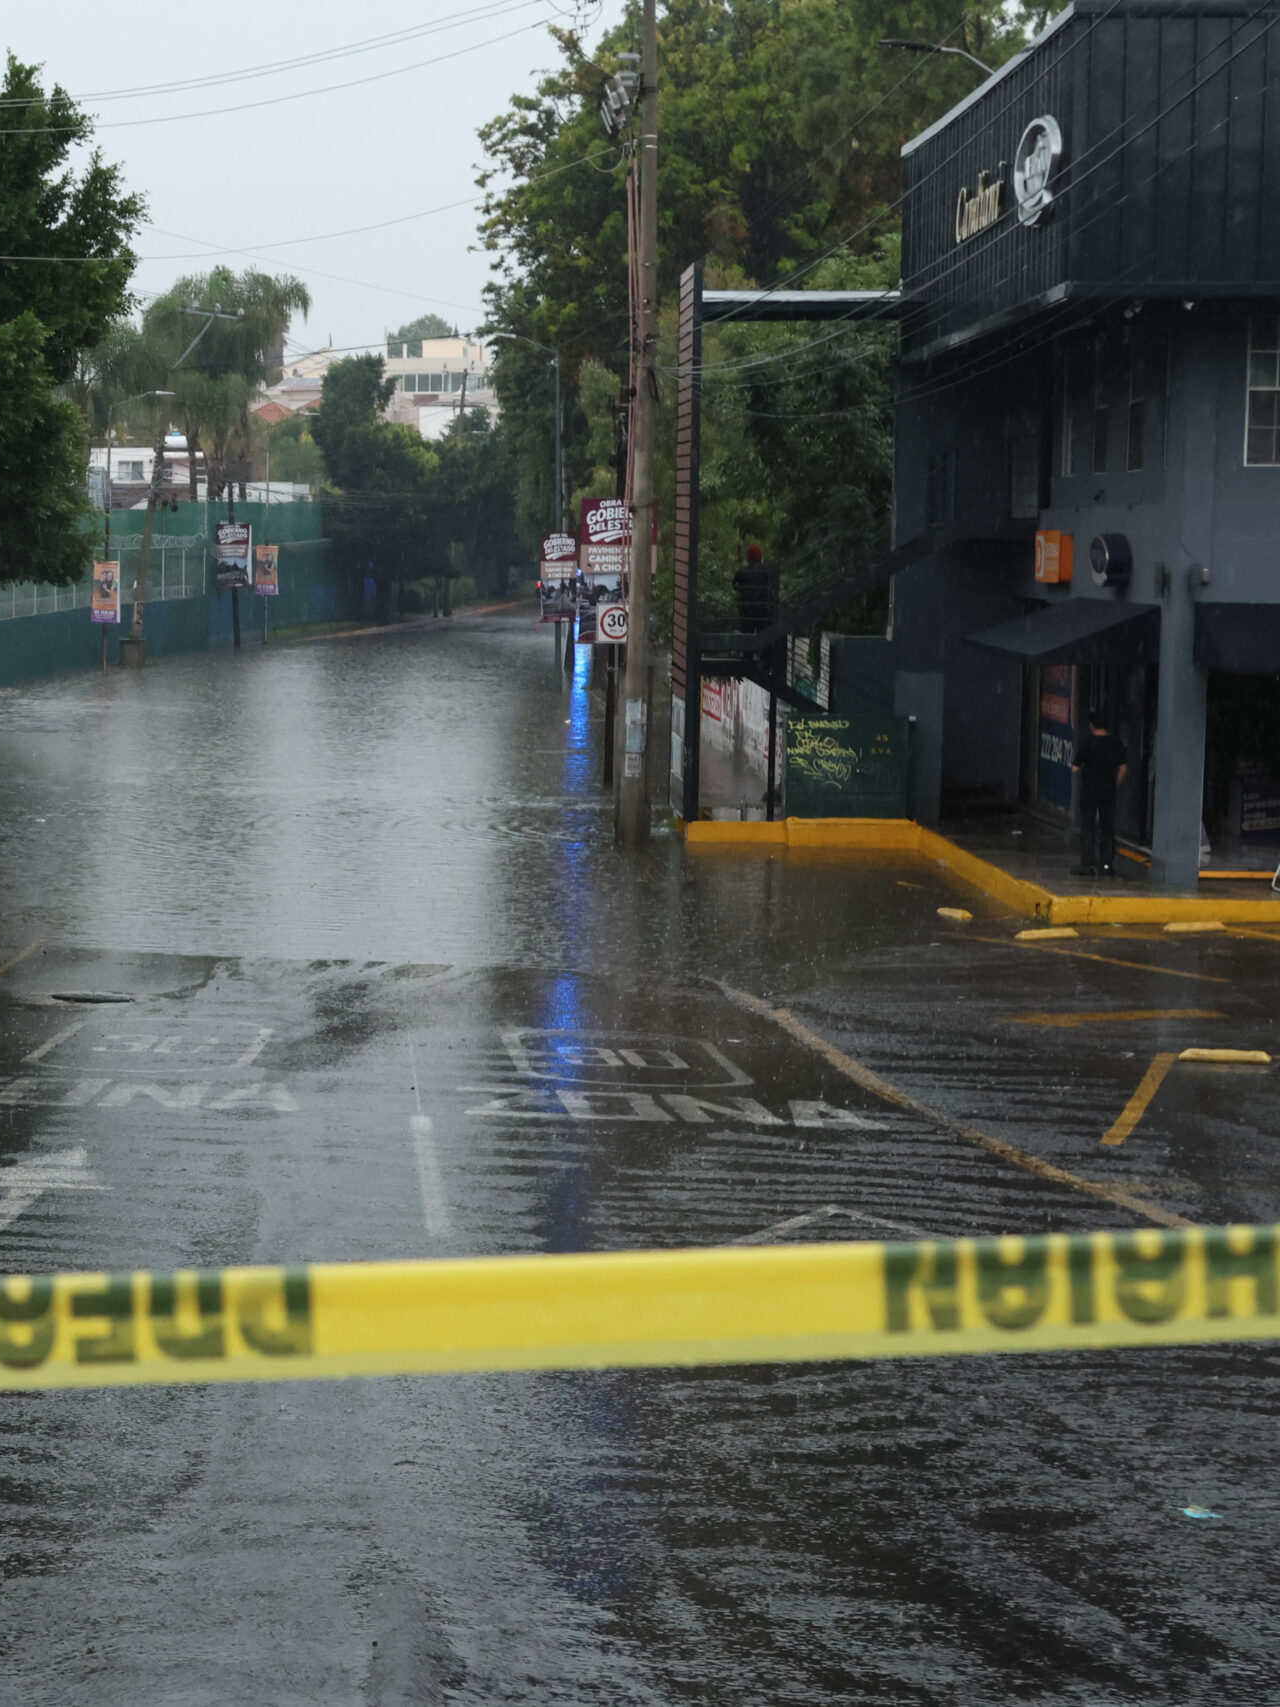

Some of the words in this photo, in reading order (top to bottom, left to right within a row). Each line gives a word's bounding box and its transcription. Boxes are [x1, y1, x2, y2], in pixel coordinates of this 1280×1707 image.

[600, 499, 622, 508] OBRA
[543, 538, 576, 549] GOBIERNO
[607, 614, 626, 627] 30
[458, 1086, 891, 1130] ZONA
